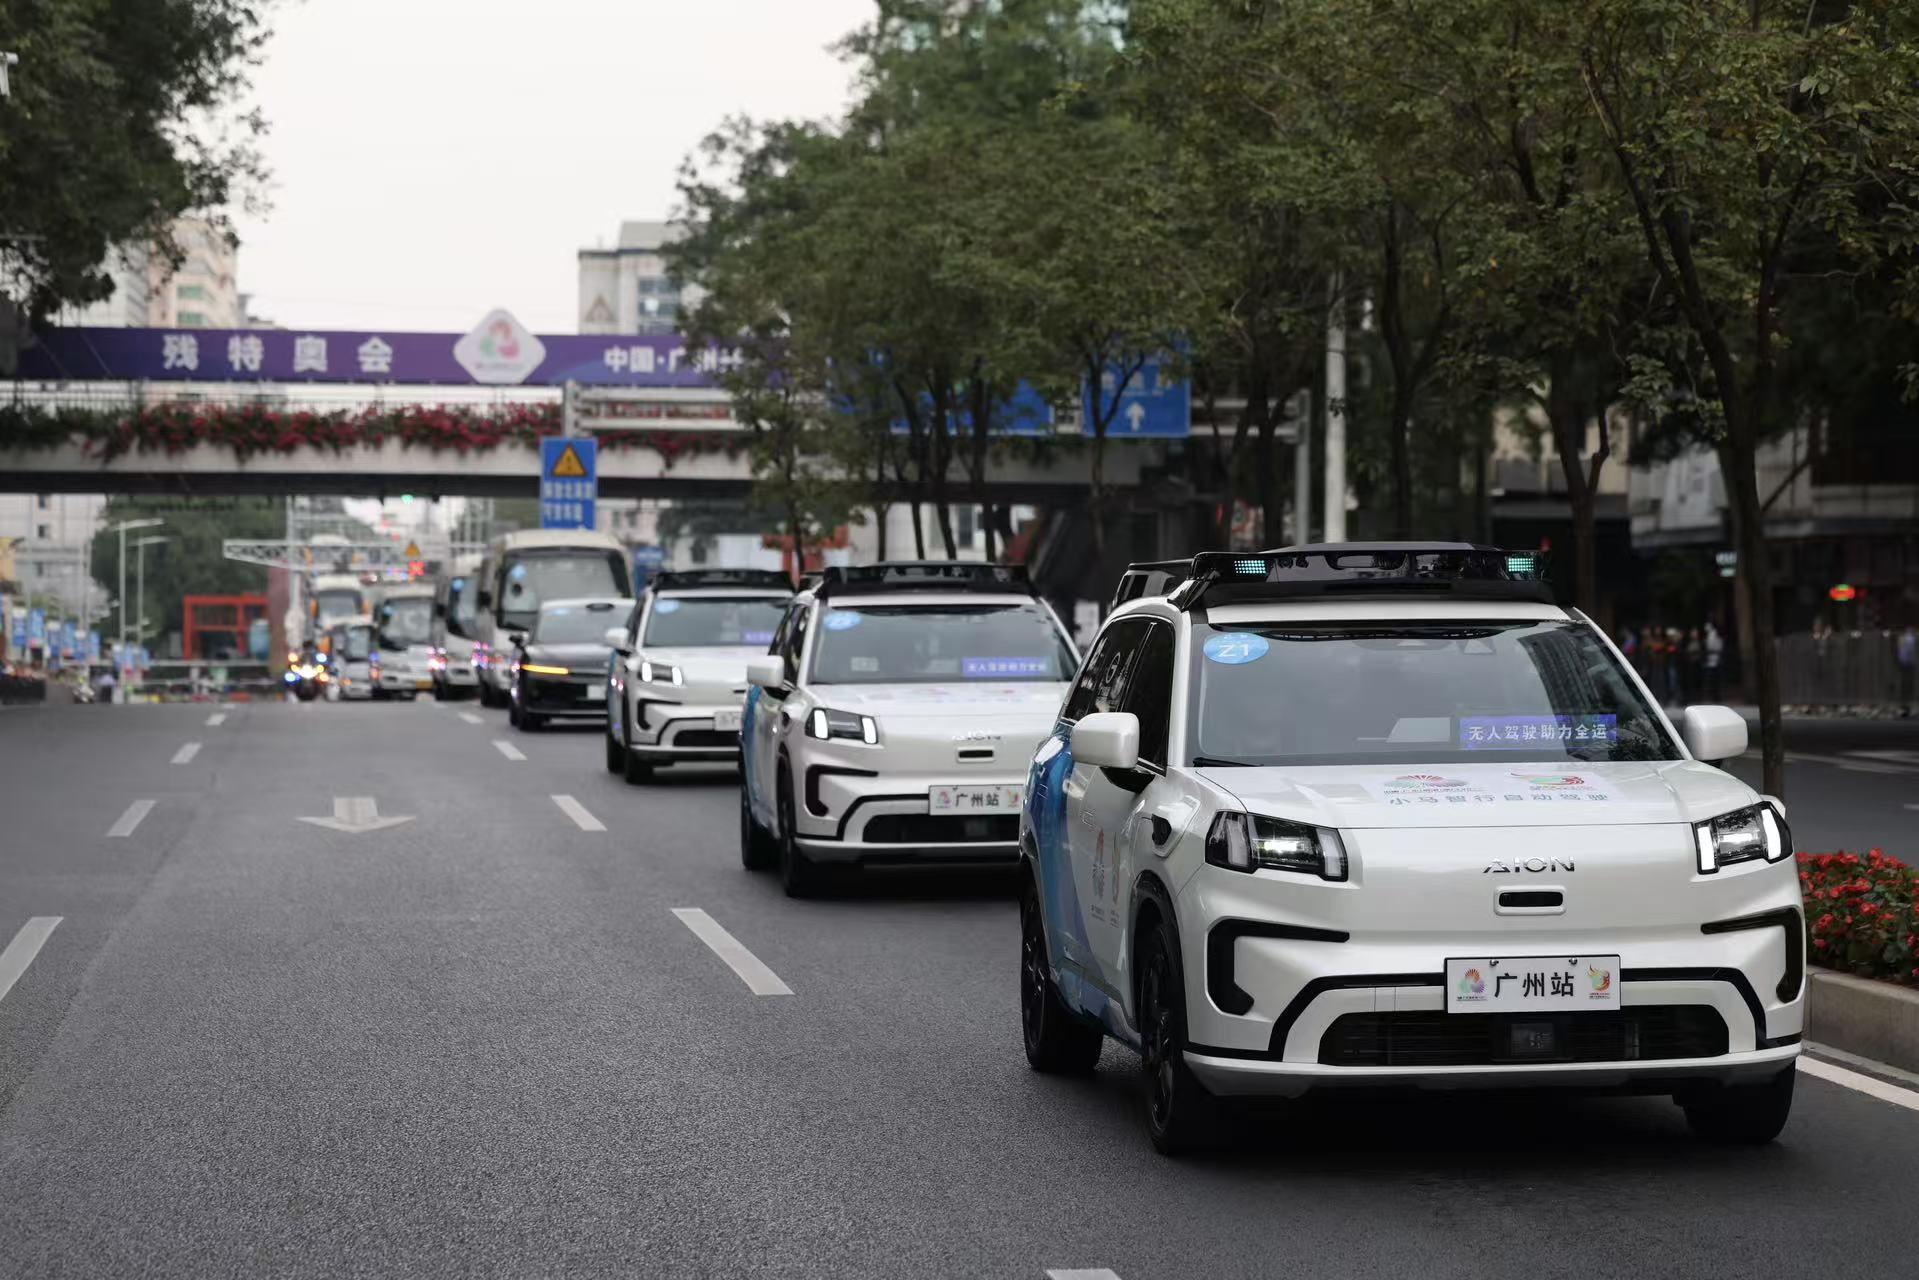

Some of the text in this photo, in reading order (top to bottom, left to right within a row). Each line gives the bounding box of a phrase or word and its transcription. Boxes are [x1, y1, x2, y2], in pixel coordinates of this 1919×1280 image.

[163, 334, 393, 371] 残特奥会
[1469, 724, 1607, 741] 无人驾驶助力全运
[955, 793, 999, 808] 广州站
[1390, 793, 1608, 805] 小马智行自动驾驶
[1483, 856, 1575, 874] AION
[1494, 971, 1575, 998] 广州站
